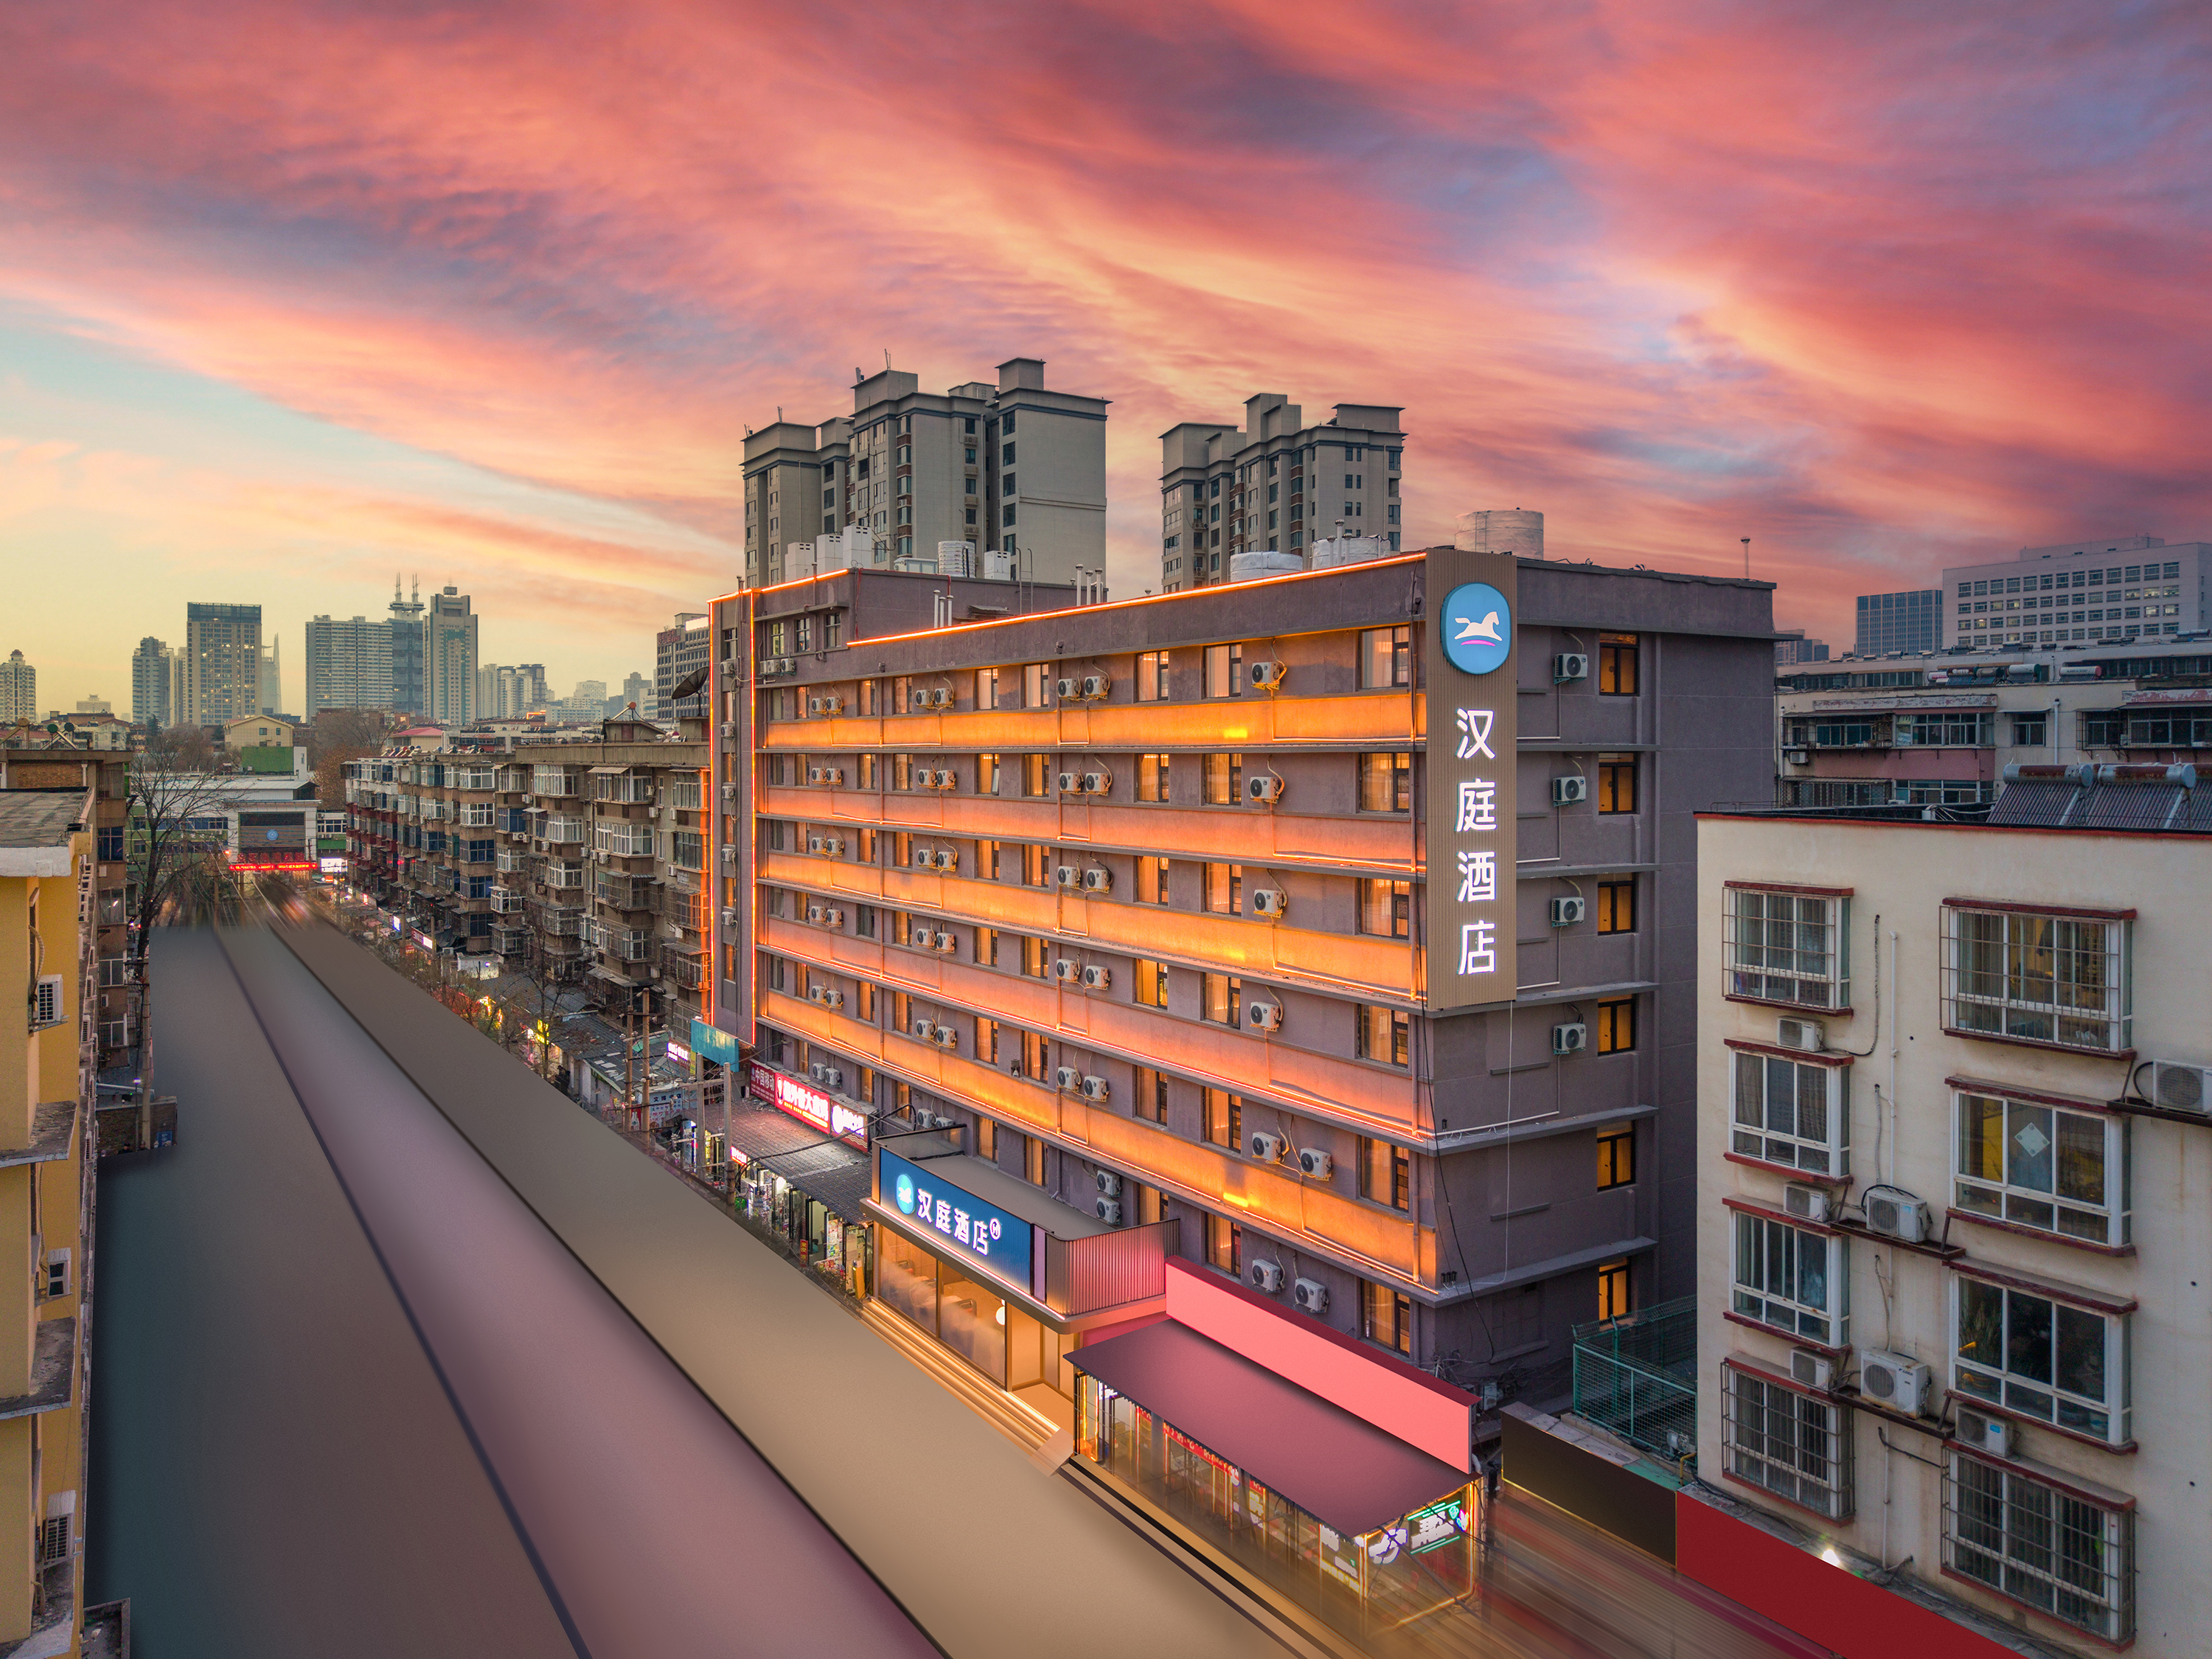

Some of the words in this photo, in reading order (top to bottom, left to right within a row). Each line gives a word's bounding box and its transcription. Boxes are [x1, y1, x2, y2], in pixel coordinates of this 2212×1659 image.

[1456, 708, 1497, 975] 汉庭酒店
[755, 1067, 775, 1092] 中国移动
[917, 1188, 989, 1256] 汉庭酒店
